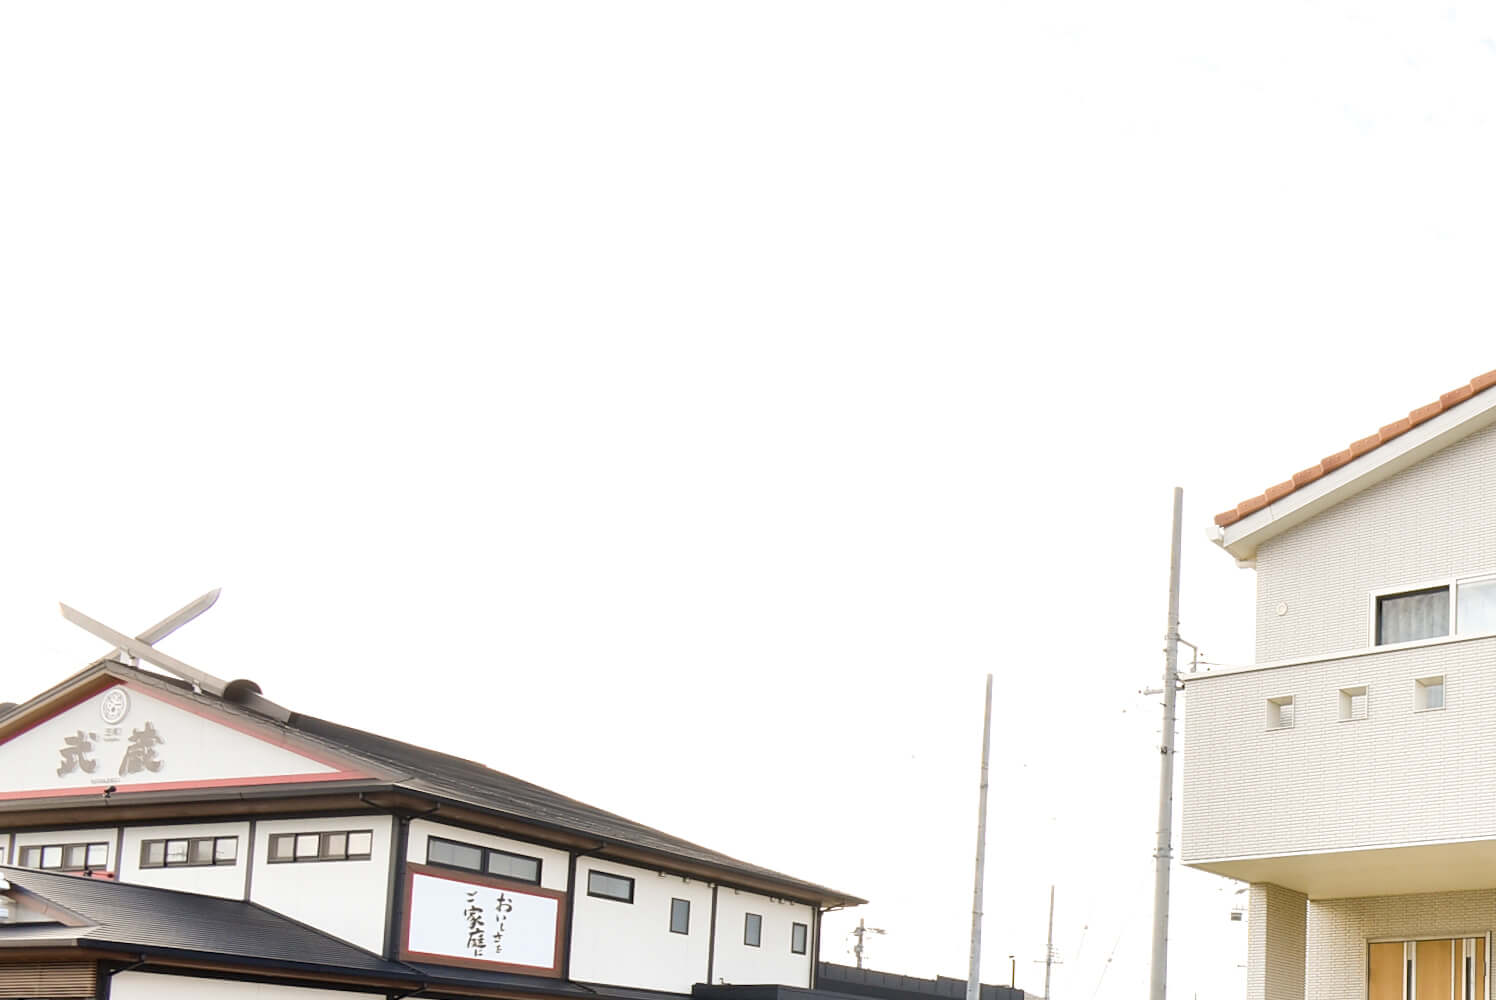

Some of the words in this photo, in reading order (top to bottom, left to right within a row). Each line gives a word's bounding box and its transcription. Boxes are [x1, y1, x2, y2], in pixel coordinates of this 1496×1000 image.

[56, 720, 164, 777] 武蔵
[463, 890, 486, 957] ご家庭に
[493, 892, 513, 954] おいしさを
